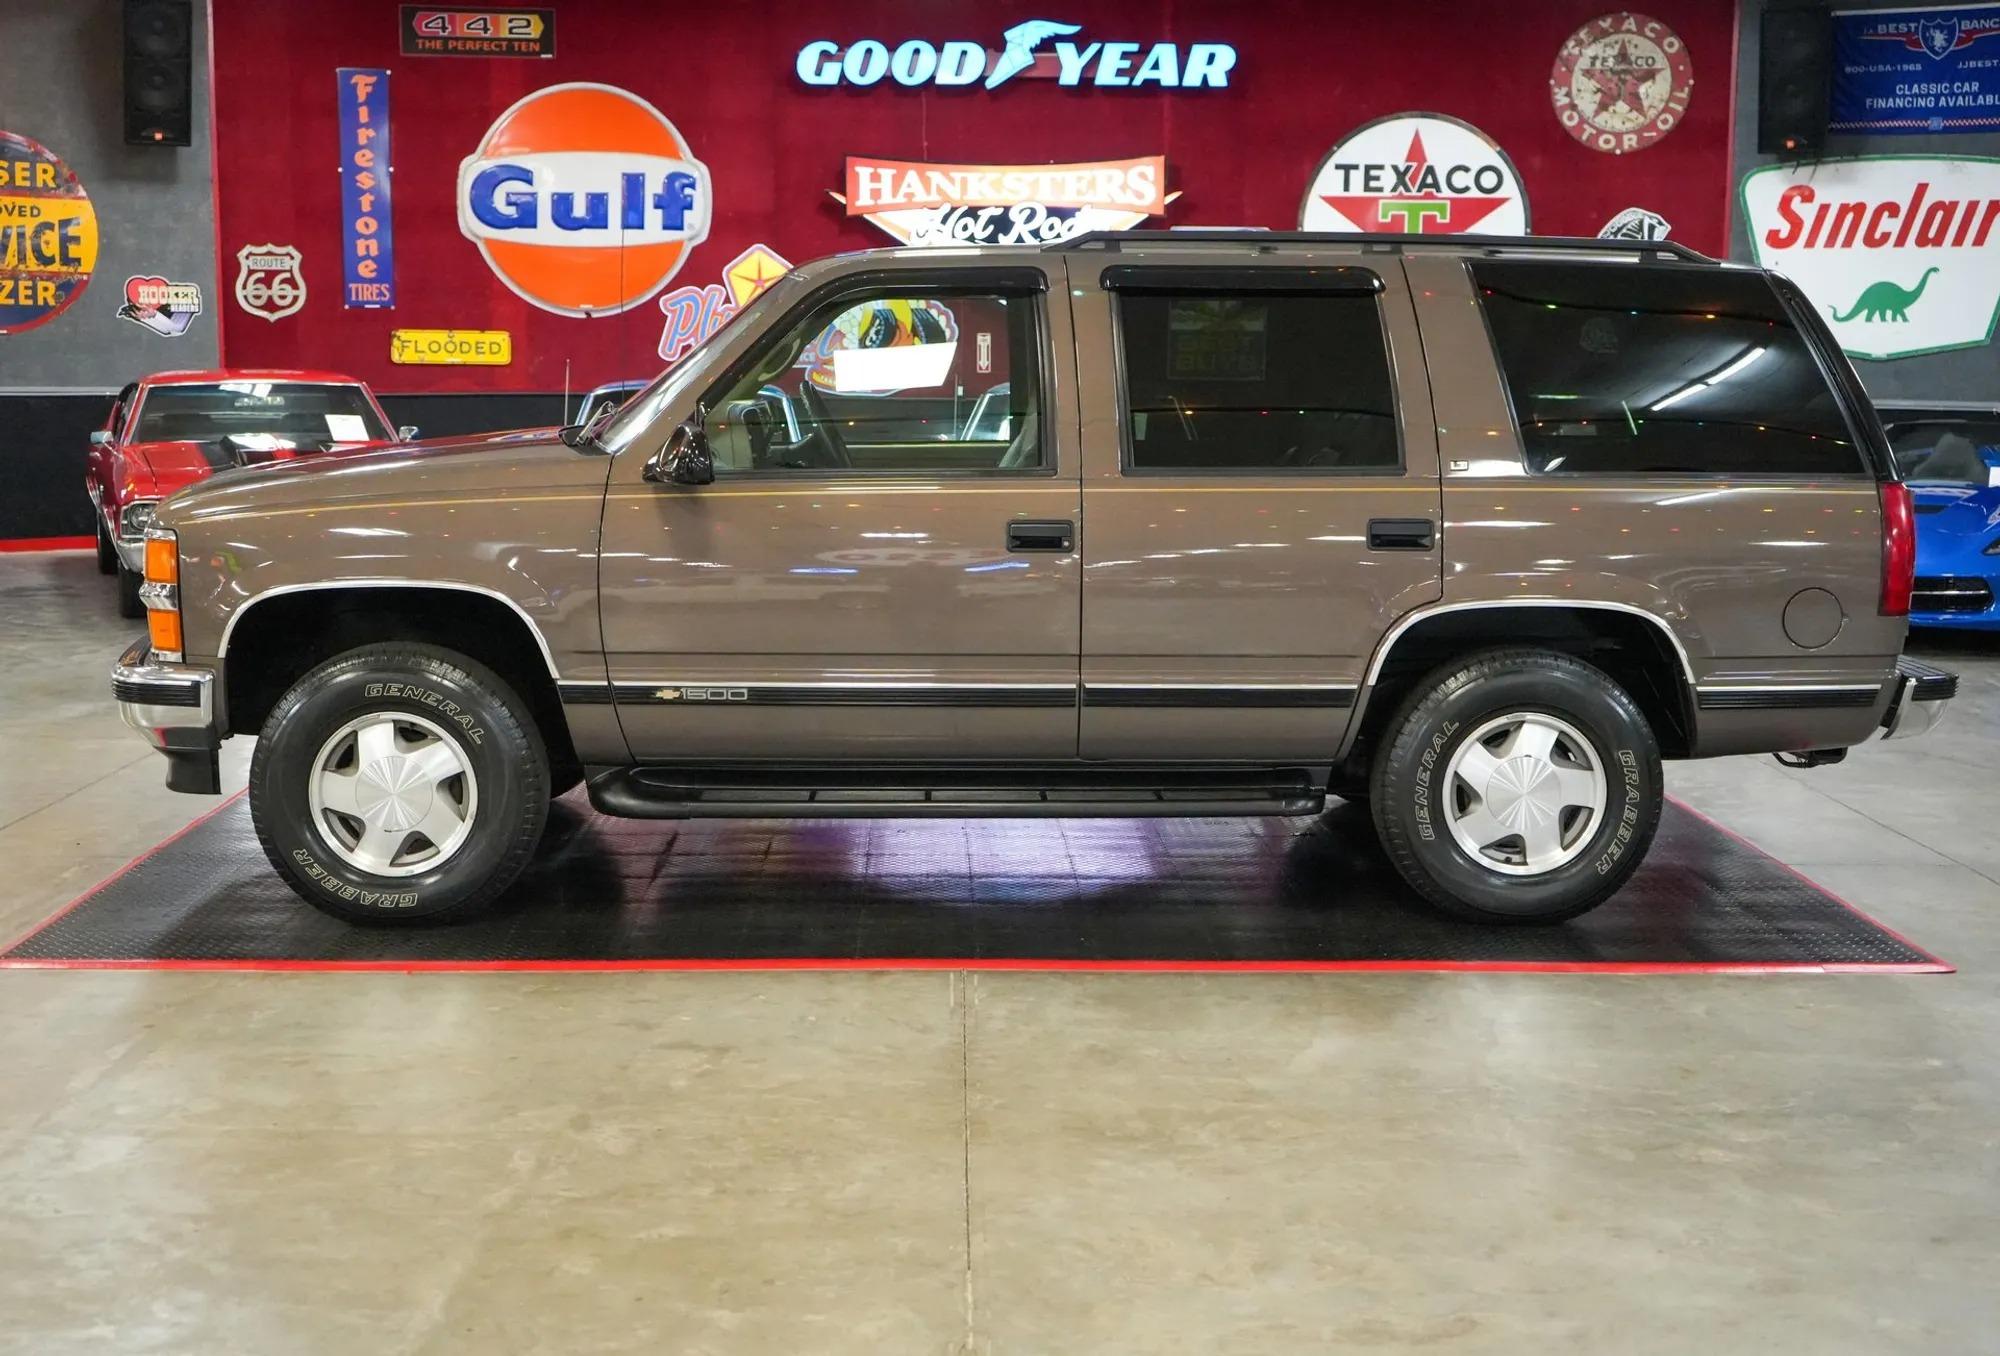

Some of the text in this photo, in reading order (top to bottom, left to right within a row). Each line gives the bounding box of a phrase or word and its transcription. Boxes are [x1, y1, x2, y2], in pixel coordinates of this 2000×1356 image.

[416, 39, 540, 52] THE PERFECT TEN
[1877, 23, 1918, 34] BEST
[796, 40, 1237, 87] GOOD YEAR
[1866, 97, 1934, 109] FINANCING
[1896, 82, 1980, 95] CLASSIC CAR
[351, 74, 380, 279] Firestone
[854, 165, 1157, 207] HANKSTERS
[1334, 163, 1504, 194] TEXACO
[470, 164, 697, 231] Gulf
[911, 203, 1004, 245] Hot
[1765, 183, 2000, 249] Sinclair
[252, 258, 286, 268] ROUTE
[138, 285, 199, 305] HOOKER
[246, 272, 292, 306] 66
[349, 283, 390, 301] TIRES
[401, 339, 502, 355] FLOODED
[681, 687, 748, 700] 1500
[365, 683, 485, 744] GENERAL
[1414, 720, 1460, 840] GENERAL
[1595, 750, 1640, 875] GRABBER
[293, 848, 418, 908] GRABBER
